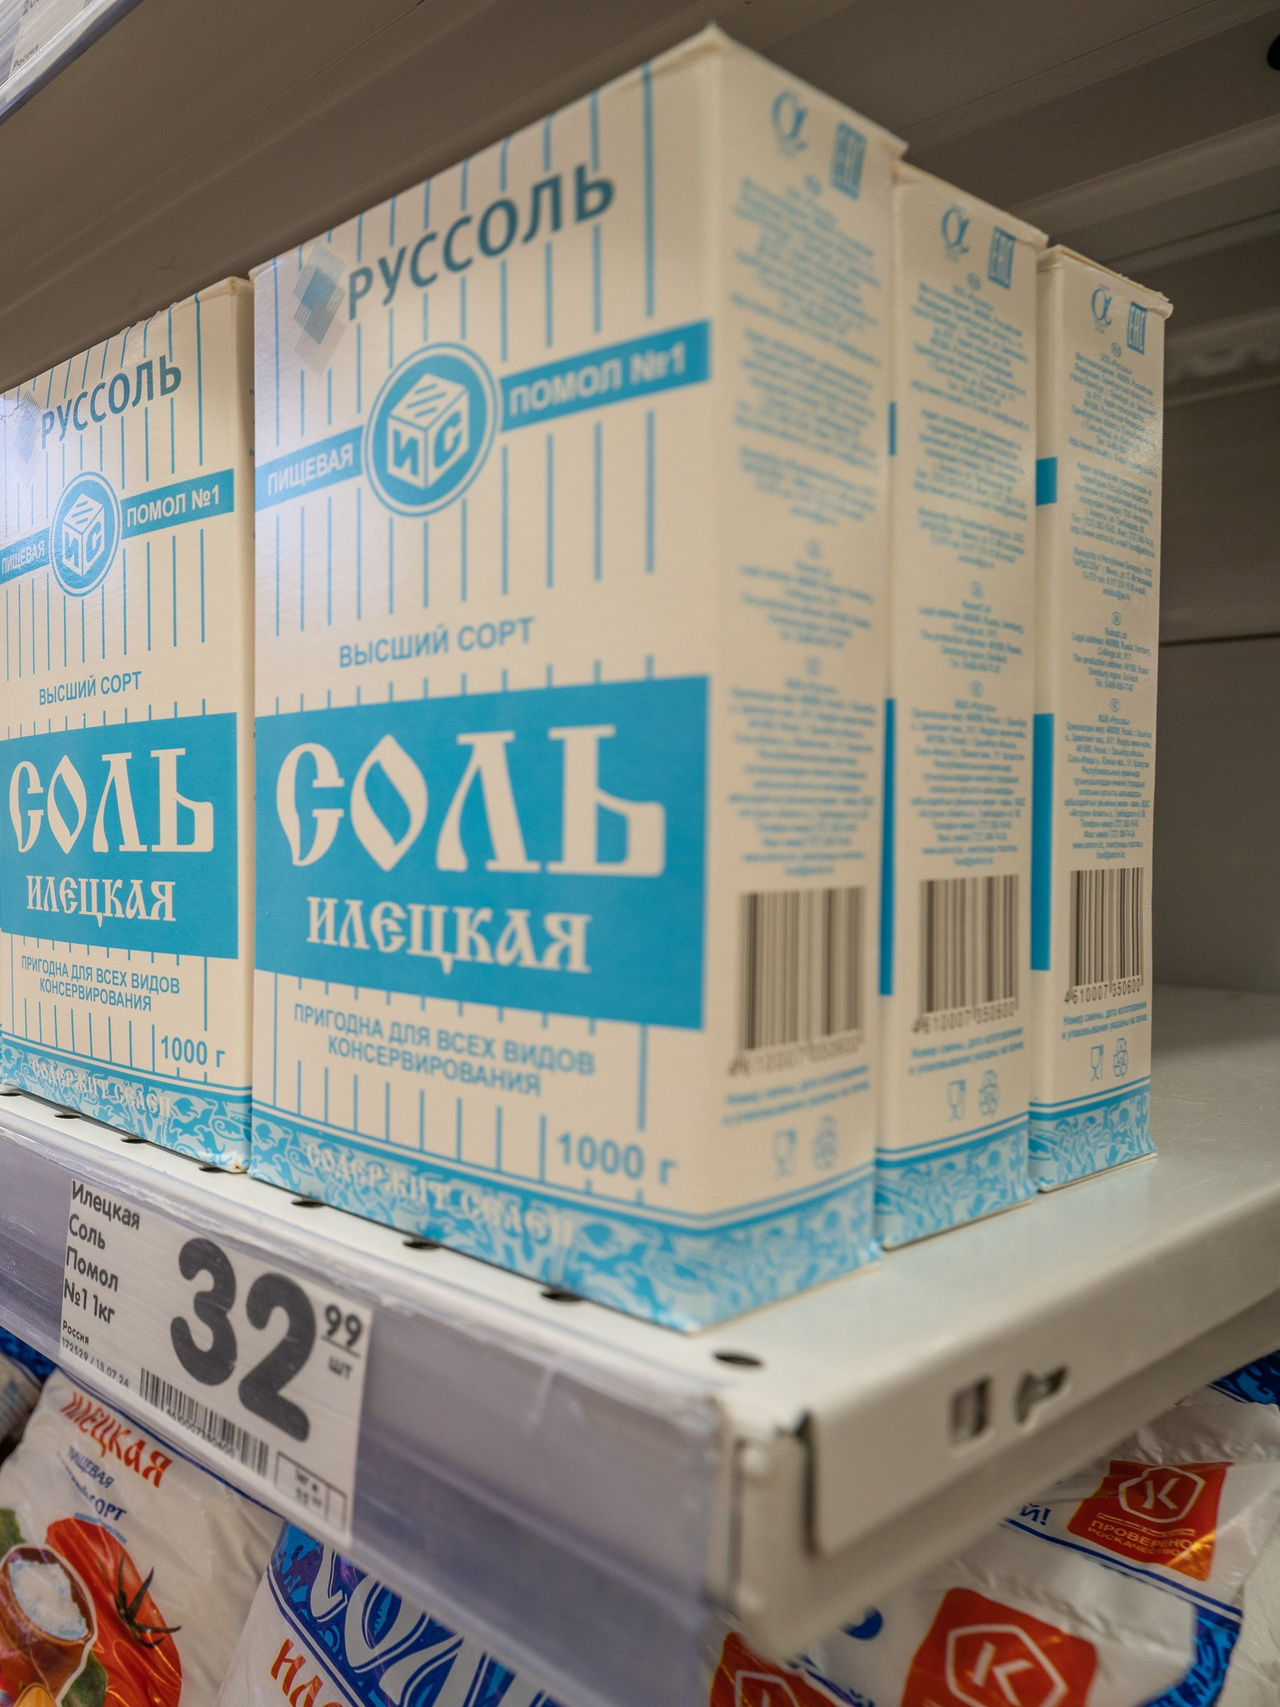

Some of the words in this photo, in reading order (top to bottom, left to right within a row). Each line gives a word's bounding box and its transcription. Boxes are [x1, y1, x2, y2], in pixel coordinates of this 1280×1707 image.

[347, 163, 615, 321] РУССОЛЬ
[41, 354, 182, 450] РУССОЛЬ
[509, 360, 622, 416] ПОМОЛ
[630, 343, 685, 385] №1
[267, 443, 354, 495] ПИЩЕВАЯ
[127, 490, 186, 528] ПОМОЛ
[192, 484, 220, 510] №1
[1, 540, 45, 574] ПИЩЕВАЯ
[339, 624, 449, 668] ВЫСШИЙ
[458, 617, 535, 652] СОРТ
[39, 673, 96, 706] ВЫСШИЙ
[101, 671, 142, 695] СОРТ
[9, 747, 214, 855] СОЛЬ
[276, 724, 666, 877] СОЛЬ
[26, 875, 176, 928] ИЛЕЦКАЯ
[306, 896, 593, 975] ИЛЕЦКАЯ
[21, 956, 70, 978] ПРИГОДНА
[71, 965, 93, 983] ДЛЯ
[96, 968, 127, 988] ВСЕХ
[131, 973, 180, 995] ВИДОВ
[39, 976, 152, 1012] КОНСЕРВИРОВАНИЯ
[160, 1035, 208, 1066] 1000
[216, 1050, 226, 1068] г
[294, 1003, 384, 1039] ПРИГОДНА
[389, 1022, 430, 1048] ДЛЯ
[437, 1028, 495, 1060] ВСЕХ
[503, 1038, 595, 1076] ВИДОВ
[327, 1035, 541, 1097] КОНСЕРВИРОВАНИЯ
[557, 1131, 644, 1180] 1000
[659, 1158, 677, 1185] г
[71, 1181, 141, 1231] Илецкая
[69, 1213, 106, 1250] Соль
[65, 1245, 119, 1293] Помол
[64, 1278, 88, 1310] №1
[93, 1293, 116, 1324] 1кг
[62, 1319, 90, 1345] Россия
[62, 1336, 89, 1362] 172529
[170, 1237, 317, 1443] 32
[324, 1304, 363, 1349] 99
